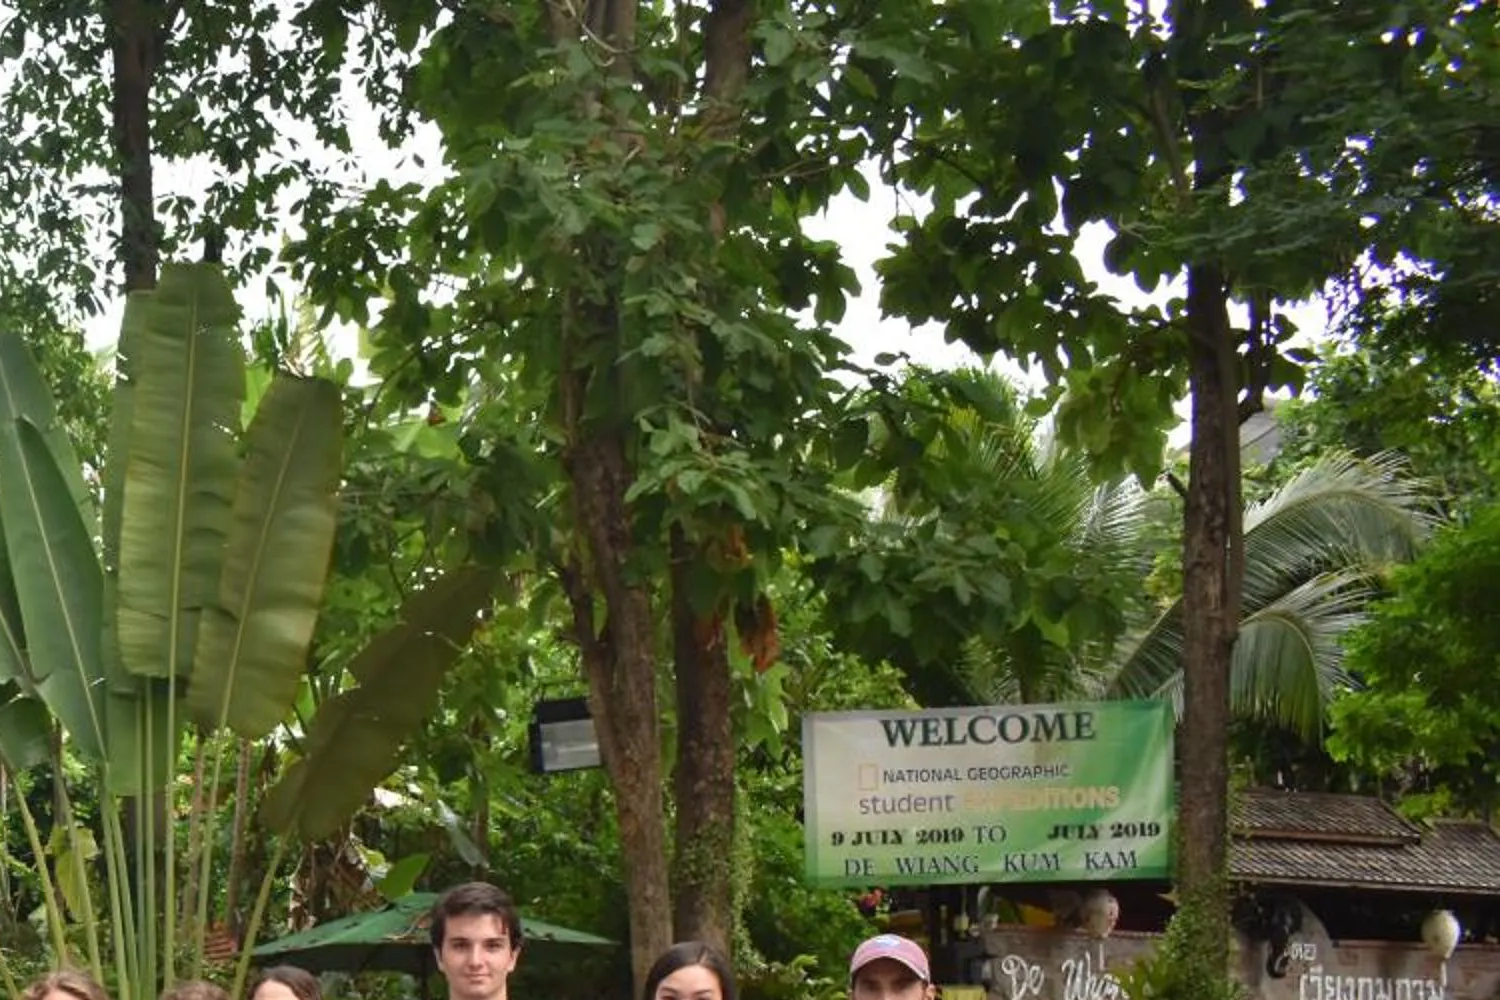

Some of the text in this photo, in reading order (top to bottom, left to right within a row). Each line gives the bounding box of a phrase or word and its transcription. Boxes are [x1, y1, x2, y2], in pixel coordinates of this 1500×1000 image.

[880, 711, 1097, 747] WELCOME
[883, 764, 1069, 783] NATIONAL GEOGRAPHIC
[859, 792, 954, 815] student
[831, 820, 1160, 846] 9 JULY 2019 TO JULY 2019
[845, 849, 1137, 877] DE WIANG KUM KAM
